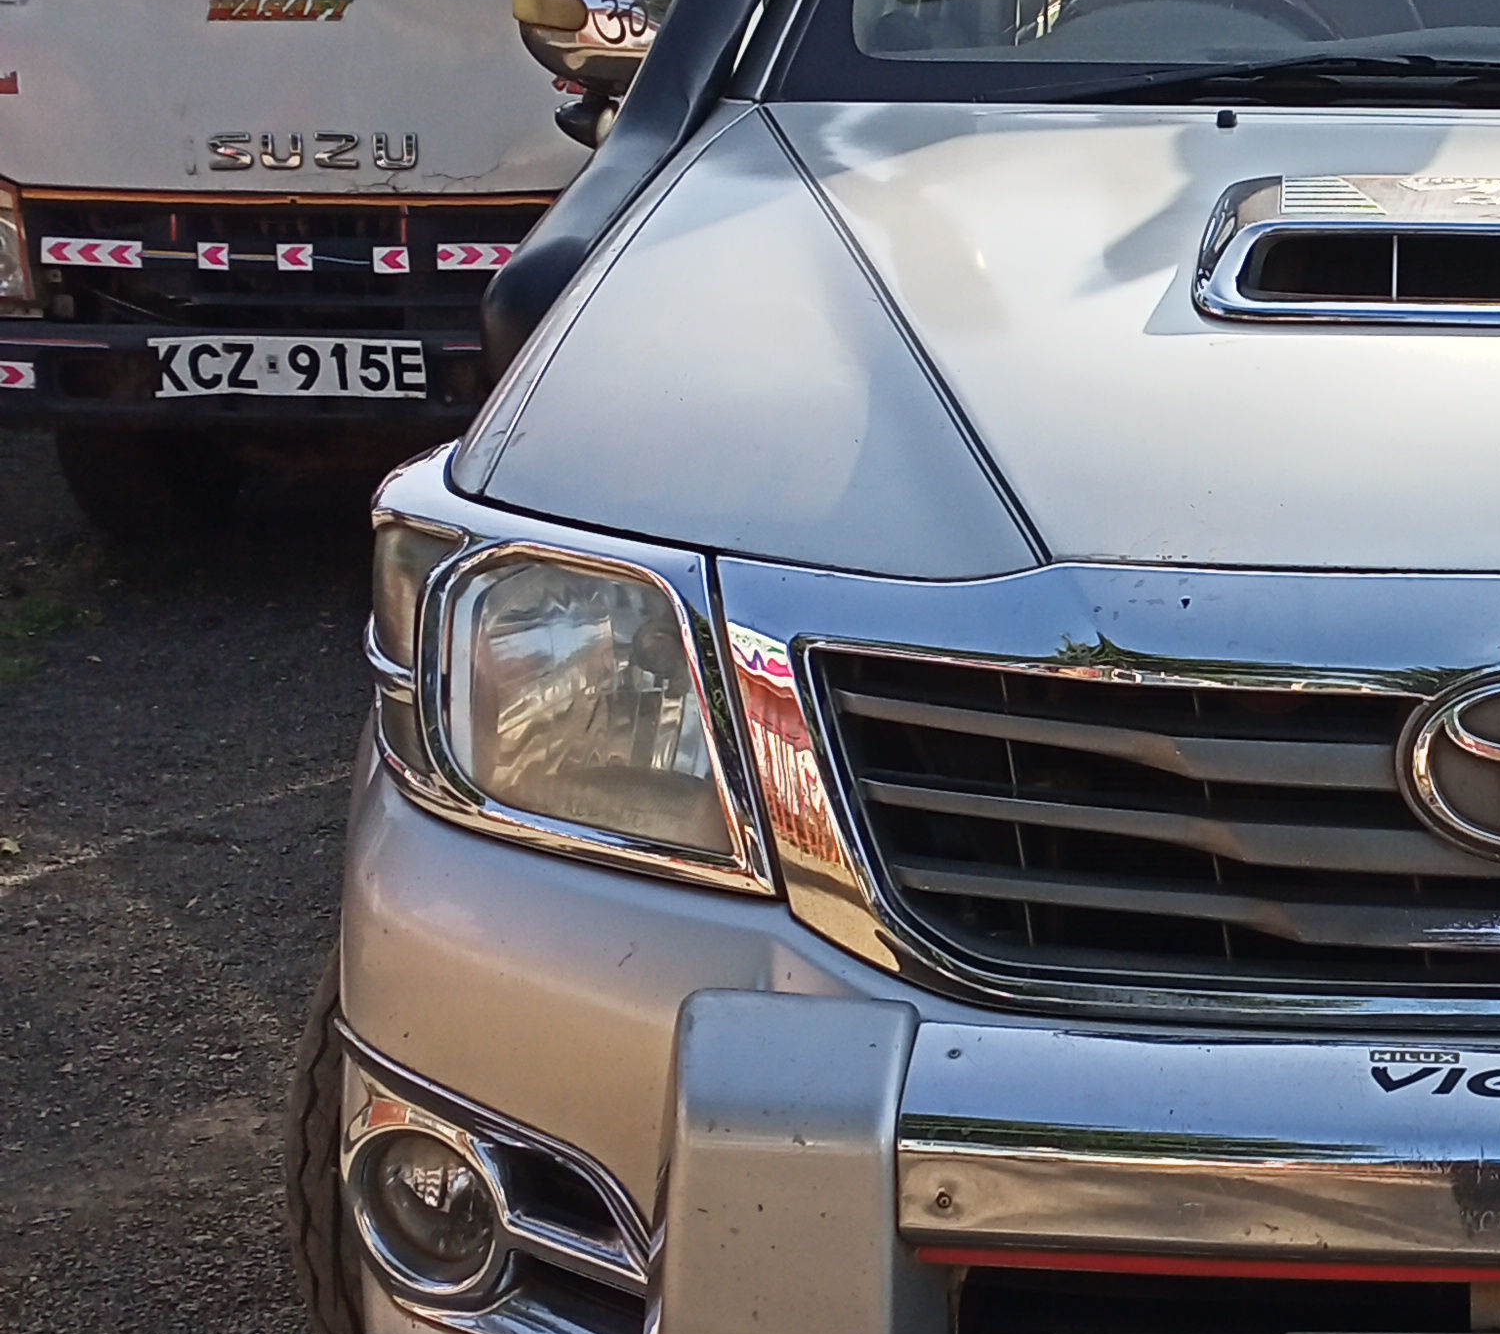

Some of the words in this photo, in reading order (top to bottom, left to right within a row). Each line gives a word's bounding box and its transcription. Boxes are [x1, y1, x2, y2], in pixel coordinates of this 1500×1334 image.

[150, 343, 259, 392] KCZ
[288, 344, 427, 392] 915E
[1372, 1051, 1457, 1063] HILUX
